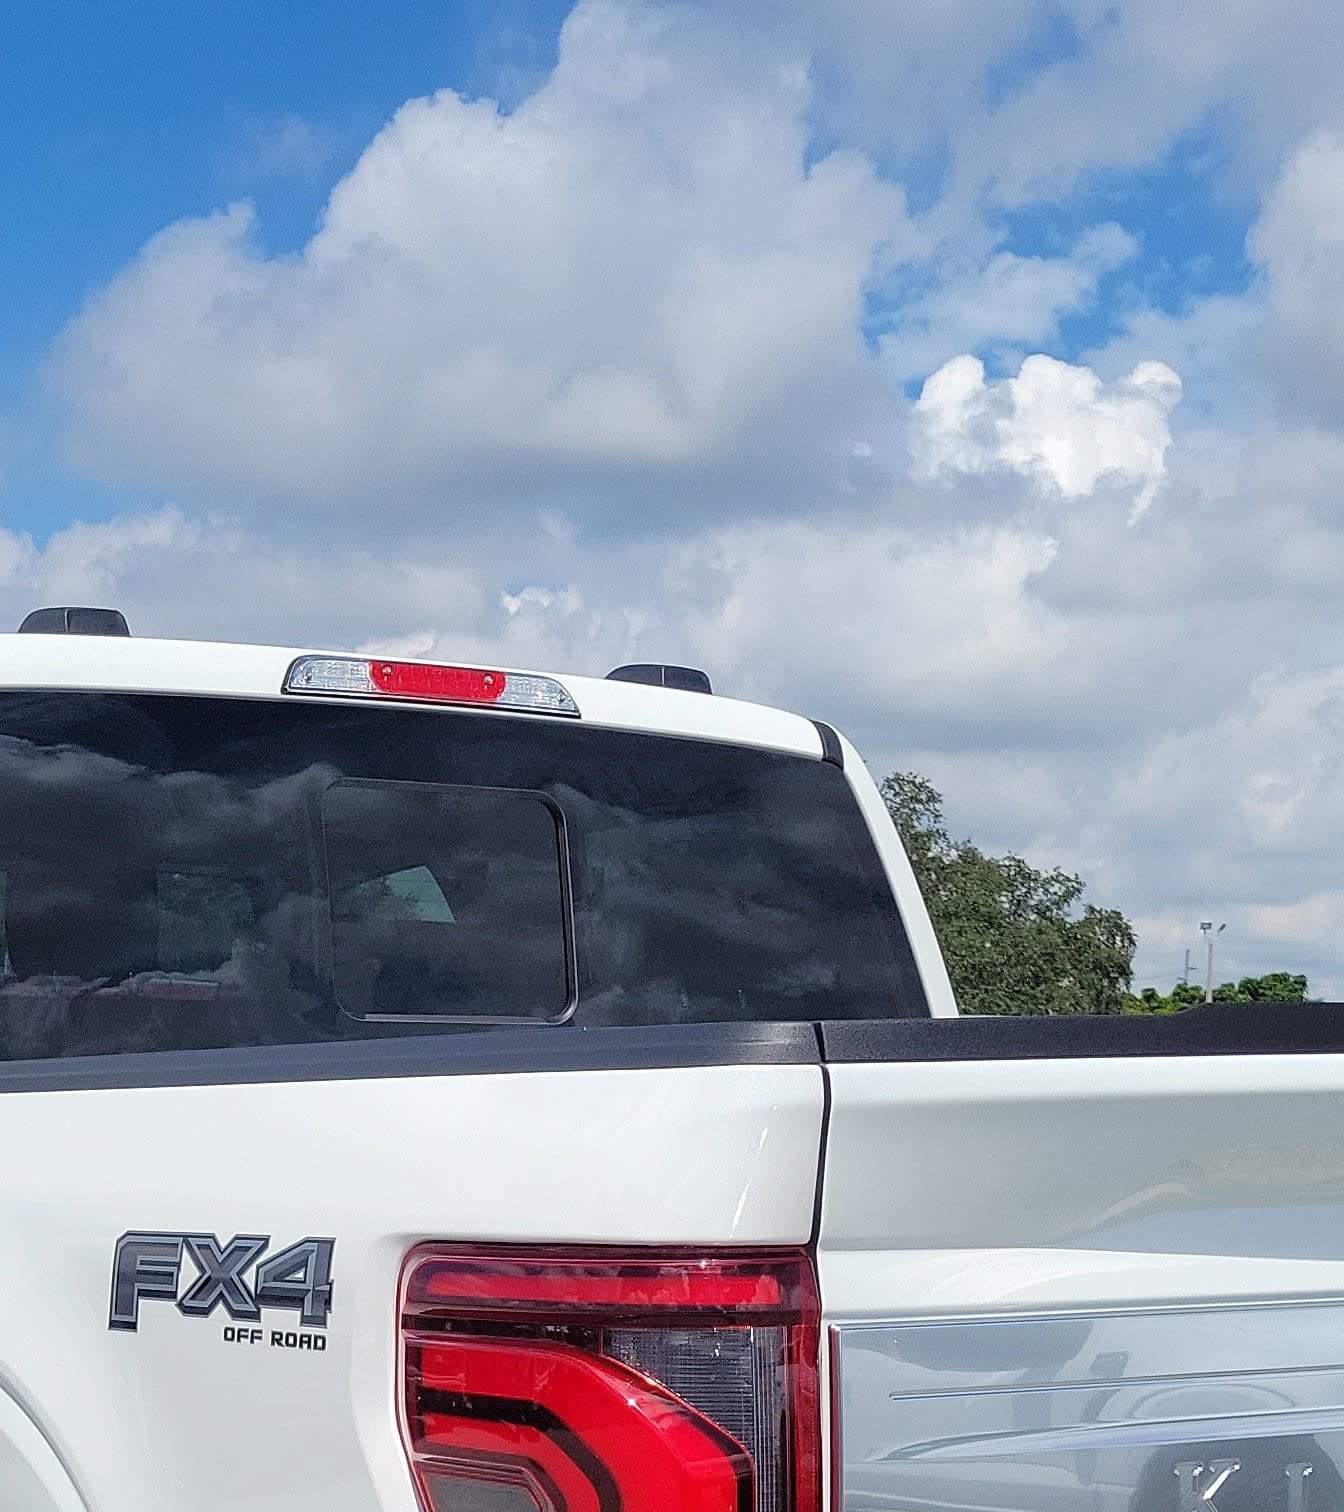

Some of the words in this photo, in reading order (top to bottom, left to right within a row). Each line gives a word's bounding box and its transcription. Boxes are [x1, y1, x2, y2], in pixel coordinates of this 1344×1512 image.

[108, 1230, 337, 1333] FX4
[223, 1326, 263, 1345] OFF
[271, 1330, 327, 1352] ROAD
